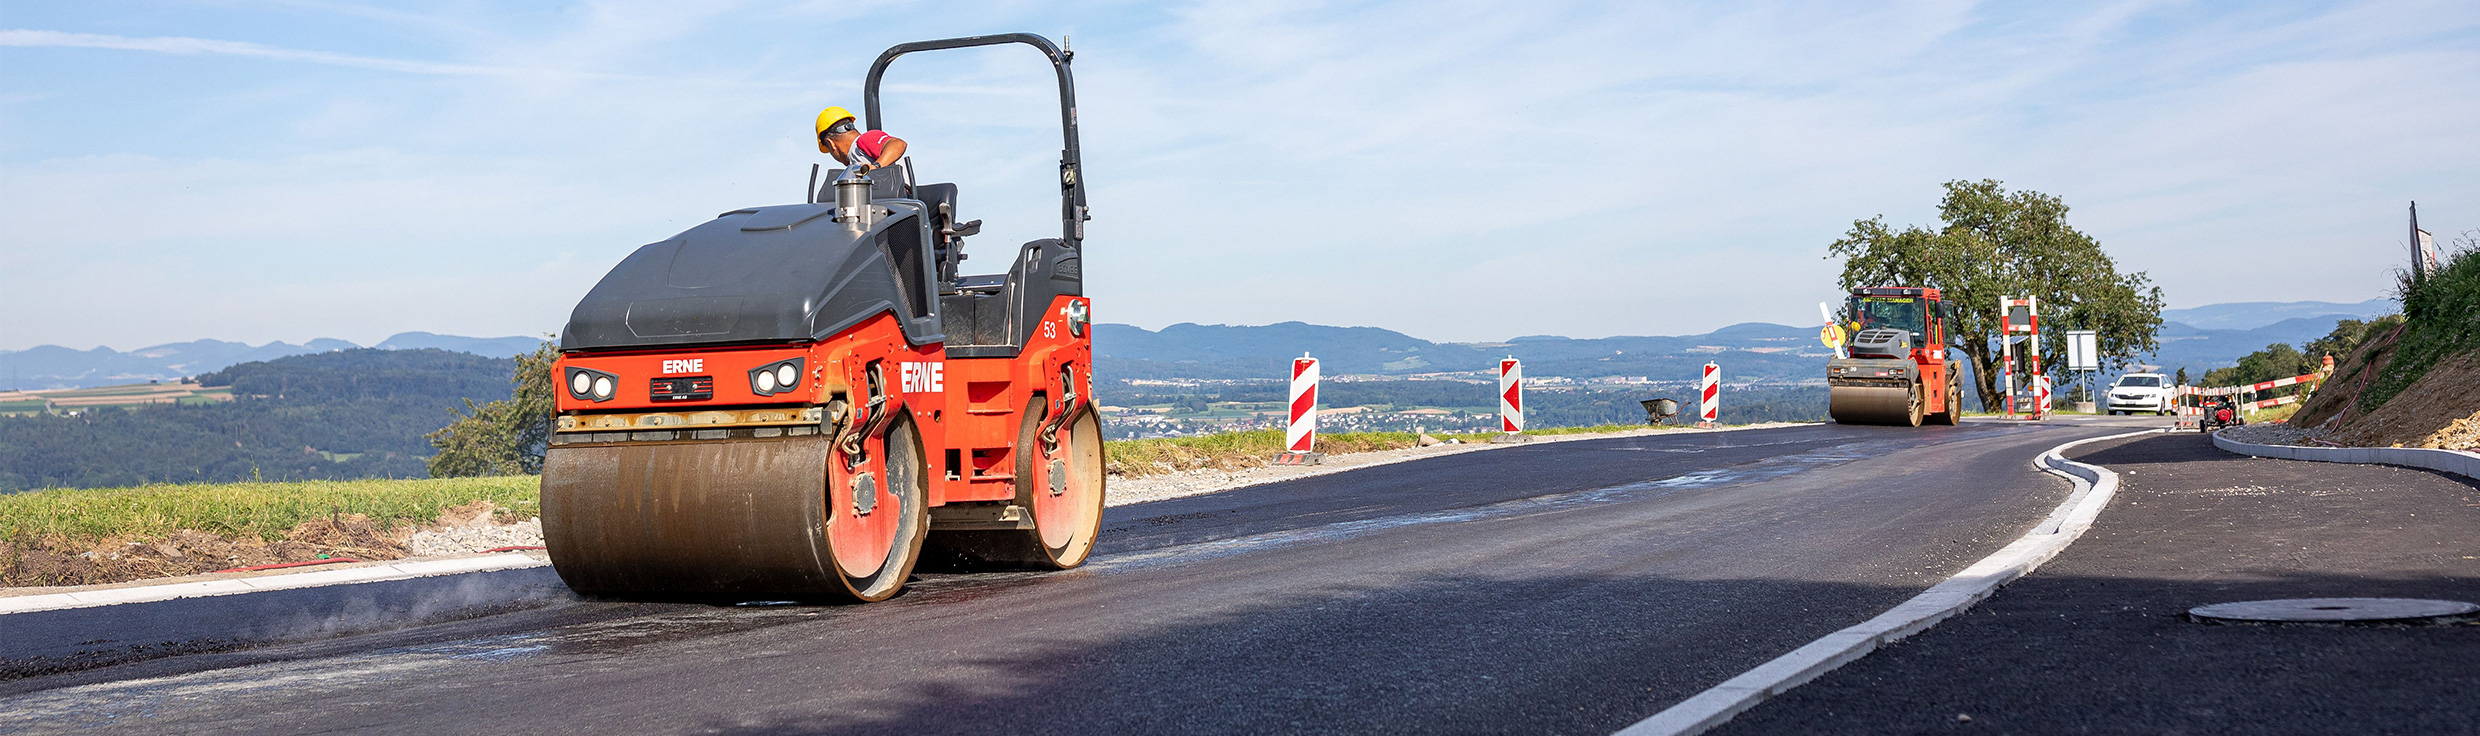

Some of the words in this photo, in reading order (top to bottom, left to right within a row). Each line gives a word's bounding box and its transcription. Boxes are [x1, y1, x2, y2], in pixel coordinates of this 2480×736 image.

[1044, 321, 1056, 339] 53
[663, 359, 703, 374] ERNE
[901, 361, 943, 393] ERNE
